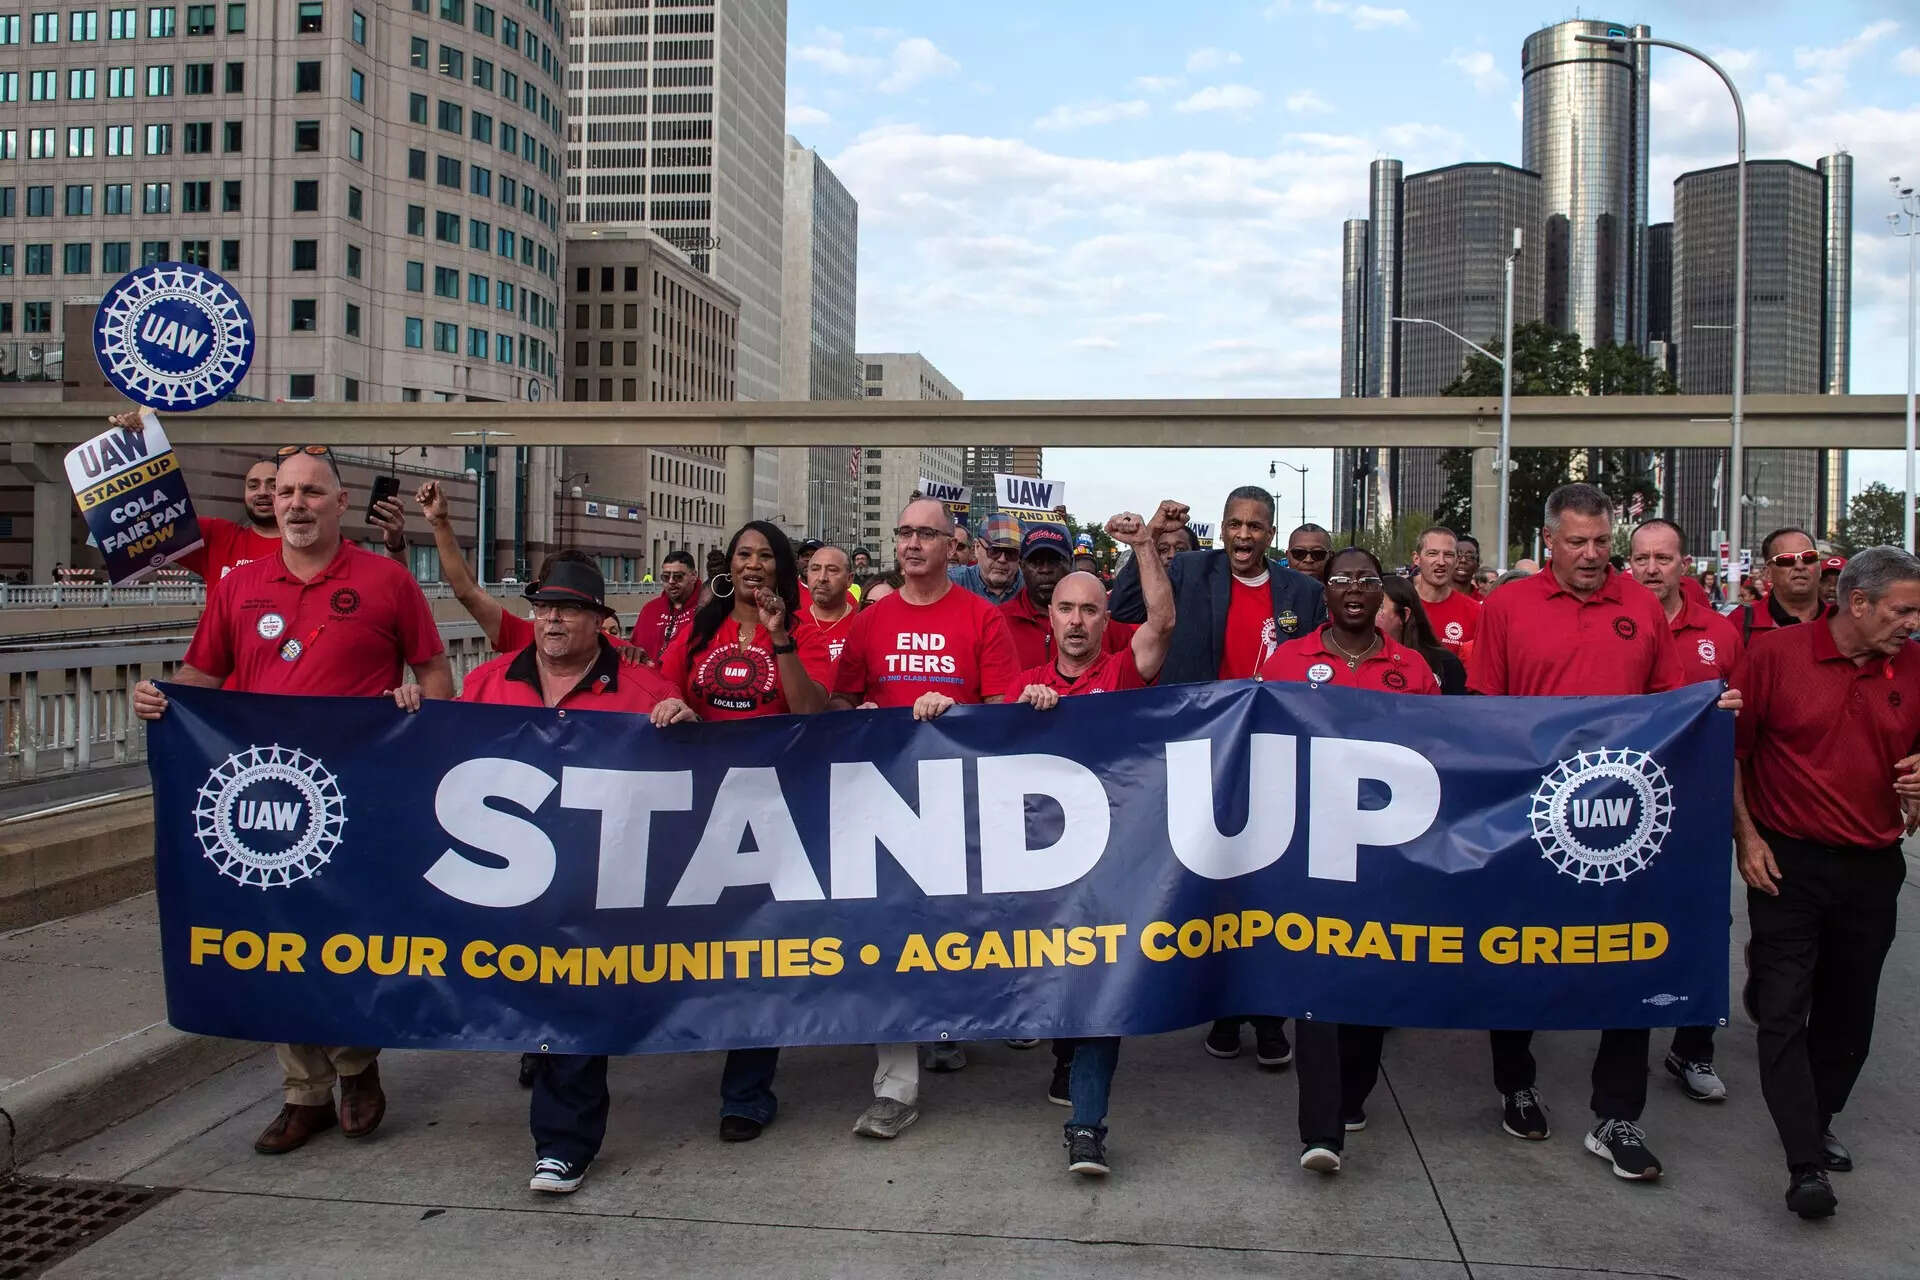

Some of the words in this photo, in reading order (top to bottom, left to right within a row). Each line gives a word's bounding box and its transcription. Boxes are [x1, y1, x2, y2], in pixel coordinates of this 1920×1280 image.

[141, 313, 208, 358] UAW
[179, 372, 204, 384] AMERICA
[78, 428, 149, 479] UAW
[85, 472, 144, 506] STAND
[146, 458, 171, 477] UP
[927, 483, 964, 501] UAW
[1006, 478, 1053, 508] UAW
[110, 488, 169, 524] COLA
[102, 521, 150, 554] FAIR
[151, 498, 188, 529] PAY
[136, 511, 150, 522] AND
[1046, 513, 1062, 522] UP
[127, 522, 175, 559] NOW
[897, 632, 945, 650] END
[725, 667, 747, 677] UAW
[885, 654, 955, 673] TIERS
[929, 676, 965, 684] WORKERS
[713, 699, 735, 708] LOCAL
[736, 701, 751, 709] 1264
[244, 767, 275, 779] AMERICA
[276, 767, 301, 780] UNITED
[1575, 767, 1603, 782] AMERICA
[1605, 766, 1631, 776] UNITED
[234, 777, 243, 786] OF
[1565, 780, 1574, 789] OF
[217, 785, 237, 816] WORKERS
[1552, 787, 1567, 816] WORKERS
[238, 800, 302, 831] UAW
[424, 754, 1110, 908] STAND
[1166, 734, 1440, 881] UP
[1573, 798, 1634, 828] UAW
[217, 816, 237, 850] IMPLEMENT
[303, 819, 321, 854] AEROSPACE
[1552, 815, 1574, 851] IMPLEMENT
[1633, 812, 1653, 847] AEROSPACE
[237, 847, 284, 866] AGRICULTURAL
[285, 851, 300, 863] AND
[1573, 849, 1619, 862] AGRICULTURAL
[1618, 846, 1633, 857] AND
[190, 926, 306, 973] FOR
[322, 933, 447, 977] OUR
[461, 937, 845, 986] COMMUNITIES
[896, 924, 1126, 974] AGAINST
[1141, 910, 1464, 964] CORPORATE
[1479, 922, 1669, 964] GREED
